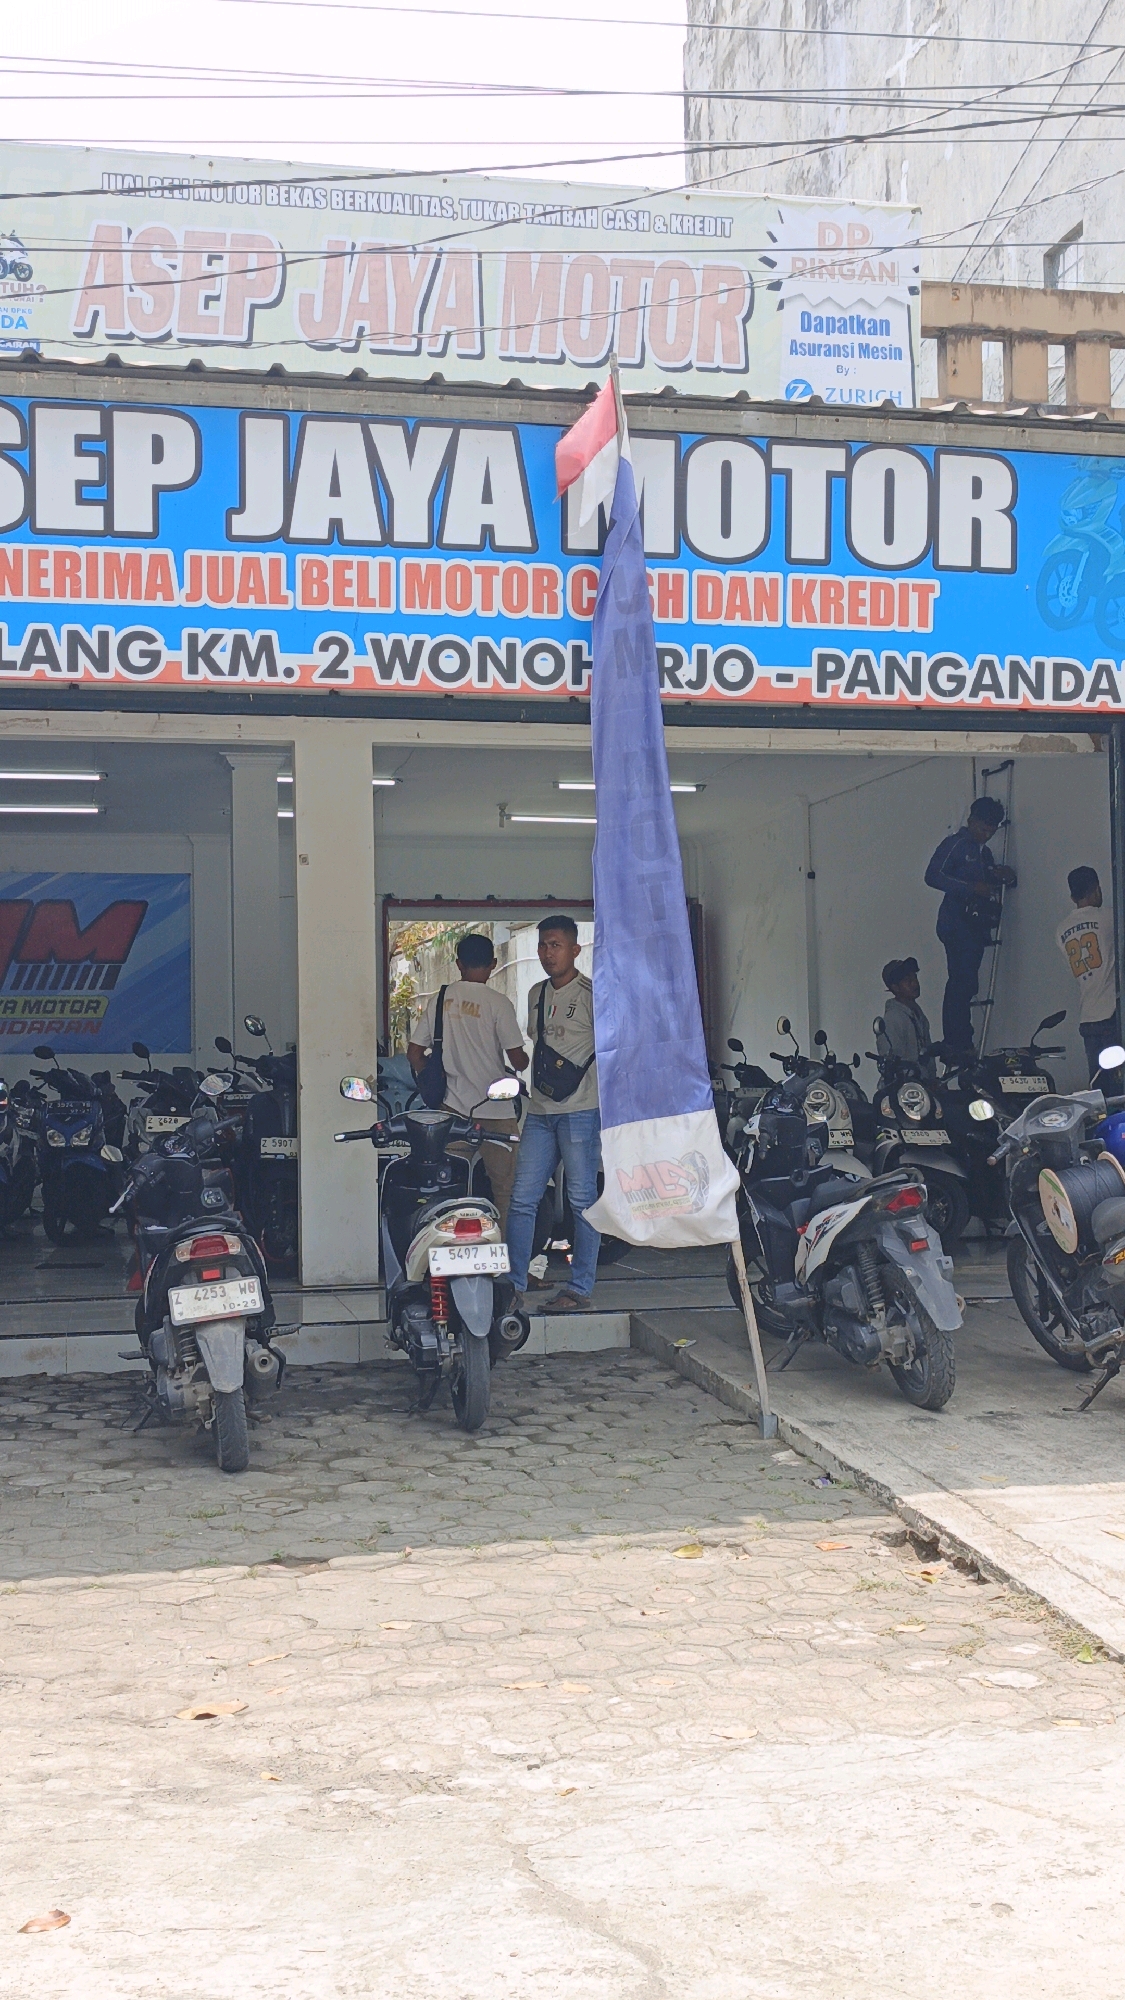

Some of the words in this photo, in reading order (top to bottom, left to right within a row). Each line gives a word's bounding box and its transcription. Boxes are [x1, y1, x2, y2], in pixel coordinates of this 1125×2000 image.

[101, 172, 145, 197] JUAL
[148, 176, 189, 200] BELI
[193, 179, 262, 205] MOTOR
[265, 184, 328, 210] BEKAS
[331, 188, 457, 221] BERKUALITAS,
[459, 198, 521, 222] TUKAR
[523, 203, 598, 228] TAMBAH
[602, 208, 650, 232] CASH
[653, 215, 668, 233] &
[670, 213, 733, 238] KREDIT
[817, 221, 872, 255] DP
[791, 257, 898, 283] RINGAN
[71, 219, 286, 344] ASEP
[299, 236, 484, 359] JAYA
[498, 247, 753, 373] MOTOR
[800, 311, 891, 337] Dapatkan
[790, 339, 855, 359] Asuransi
[858, 342, 903, 361] Mesin
[836, 365, 850, 376] By
[825, 387, 902, 406] ZURICH
[226, 411, 538, 553] JAYA
[561, 430, 1017, 574] MOTOR
[186, 554, 289, 606] JUAL
[301, 559, 391, 611] BELI
[404, 562, 560, 616] MOTOR
[567, 565, 684, 624] CH
[694, 575, 780, 623] DAN
[790, 579, 936, 629] KREDIT
[188, 633, 295, 681] KM.
[319, 636, 350, 679] 2
[372, 639, 755, 692] WONOHRJO
[816, 652, 1122, 703] PANGANDA
[1065, 931, 1102, 978] 23
[21, 999, 101, 1014] MOTOR
[262, 1139, 267, 1148] Z
[271, 1138, 293, 1148] 5907
[431, 1250, 438, 1262] Z
[174, 1292, 182, 1305] Z
[193, 1284, 227, 1302] 4253
